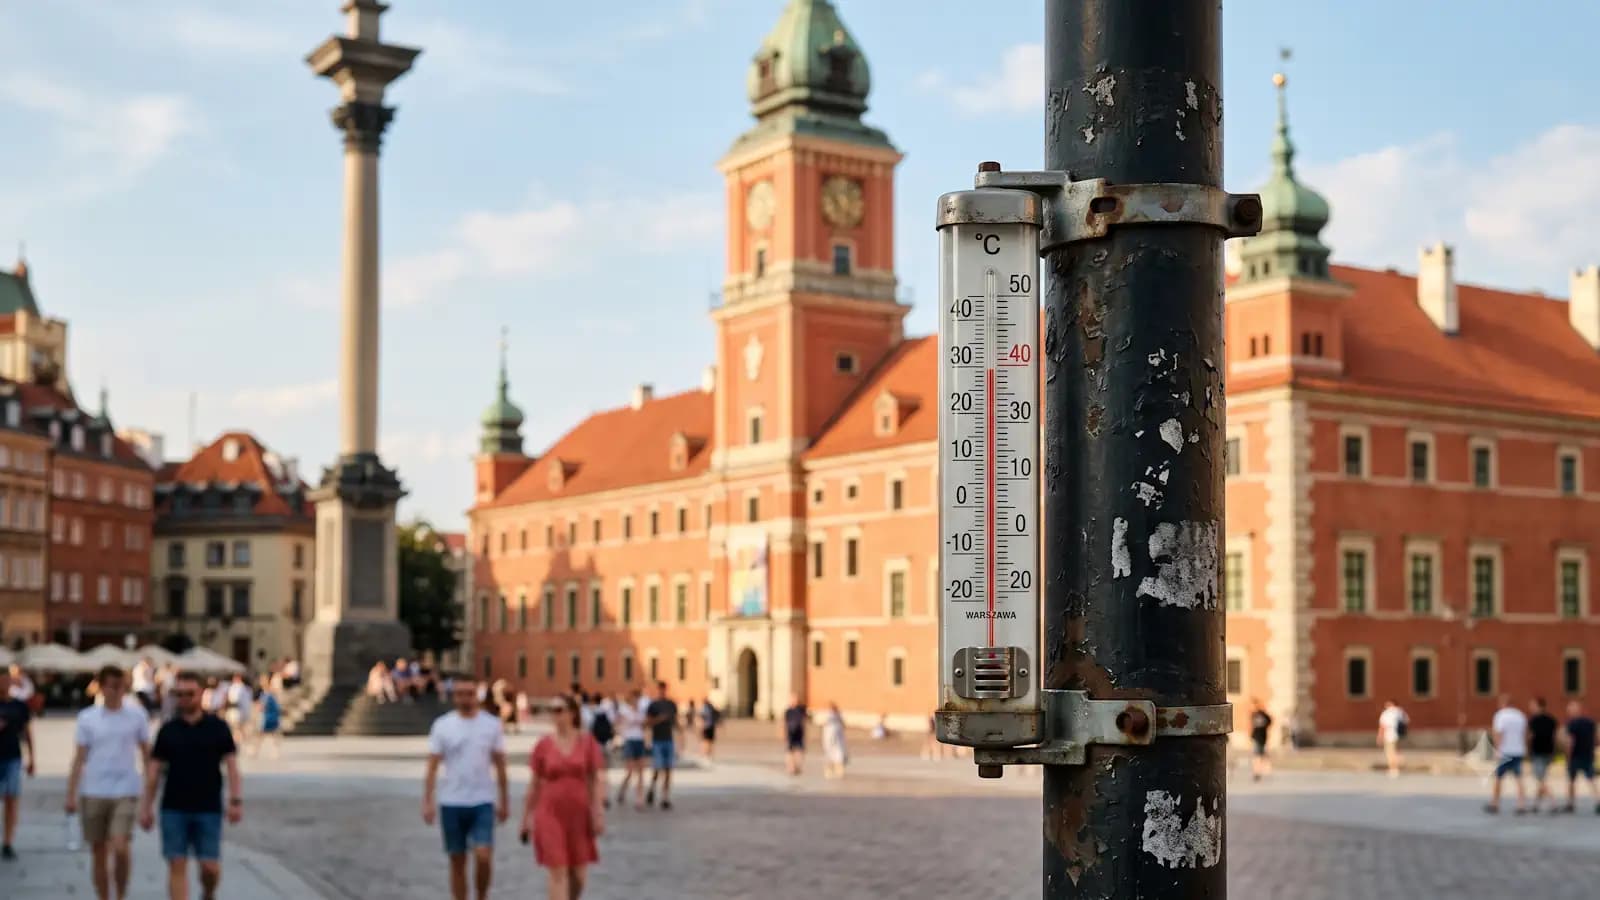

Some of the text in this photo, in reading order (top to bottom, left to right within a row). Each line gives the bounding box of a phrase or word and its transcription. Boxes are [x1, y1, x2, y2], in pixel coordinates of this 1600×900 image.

[975, 233, 1001, 255] °C
[1009, 274, 1031, 293] 50
[950, 299, 972, 318] 40
[950, 345, 972, 365] 30
[1009, 344, 1031, 362] 40
[951, 392, 972, 411] 20
[1010, 401, 1031, 420] 30
[951, 439, 972, 458] 10
[1010, 458, 1031, 476] 10
[956, 486, 967, 504] 0
[1015, 514, 1026, 533] 0
[946, 533, 972, 552] -10
[945, 580, 972, 598] -20
[1010, 571, 1031, 589] 20
[965, 611, 1017, 620] WARSZAWA
